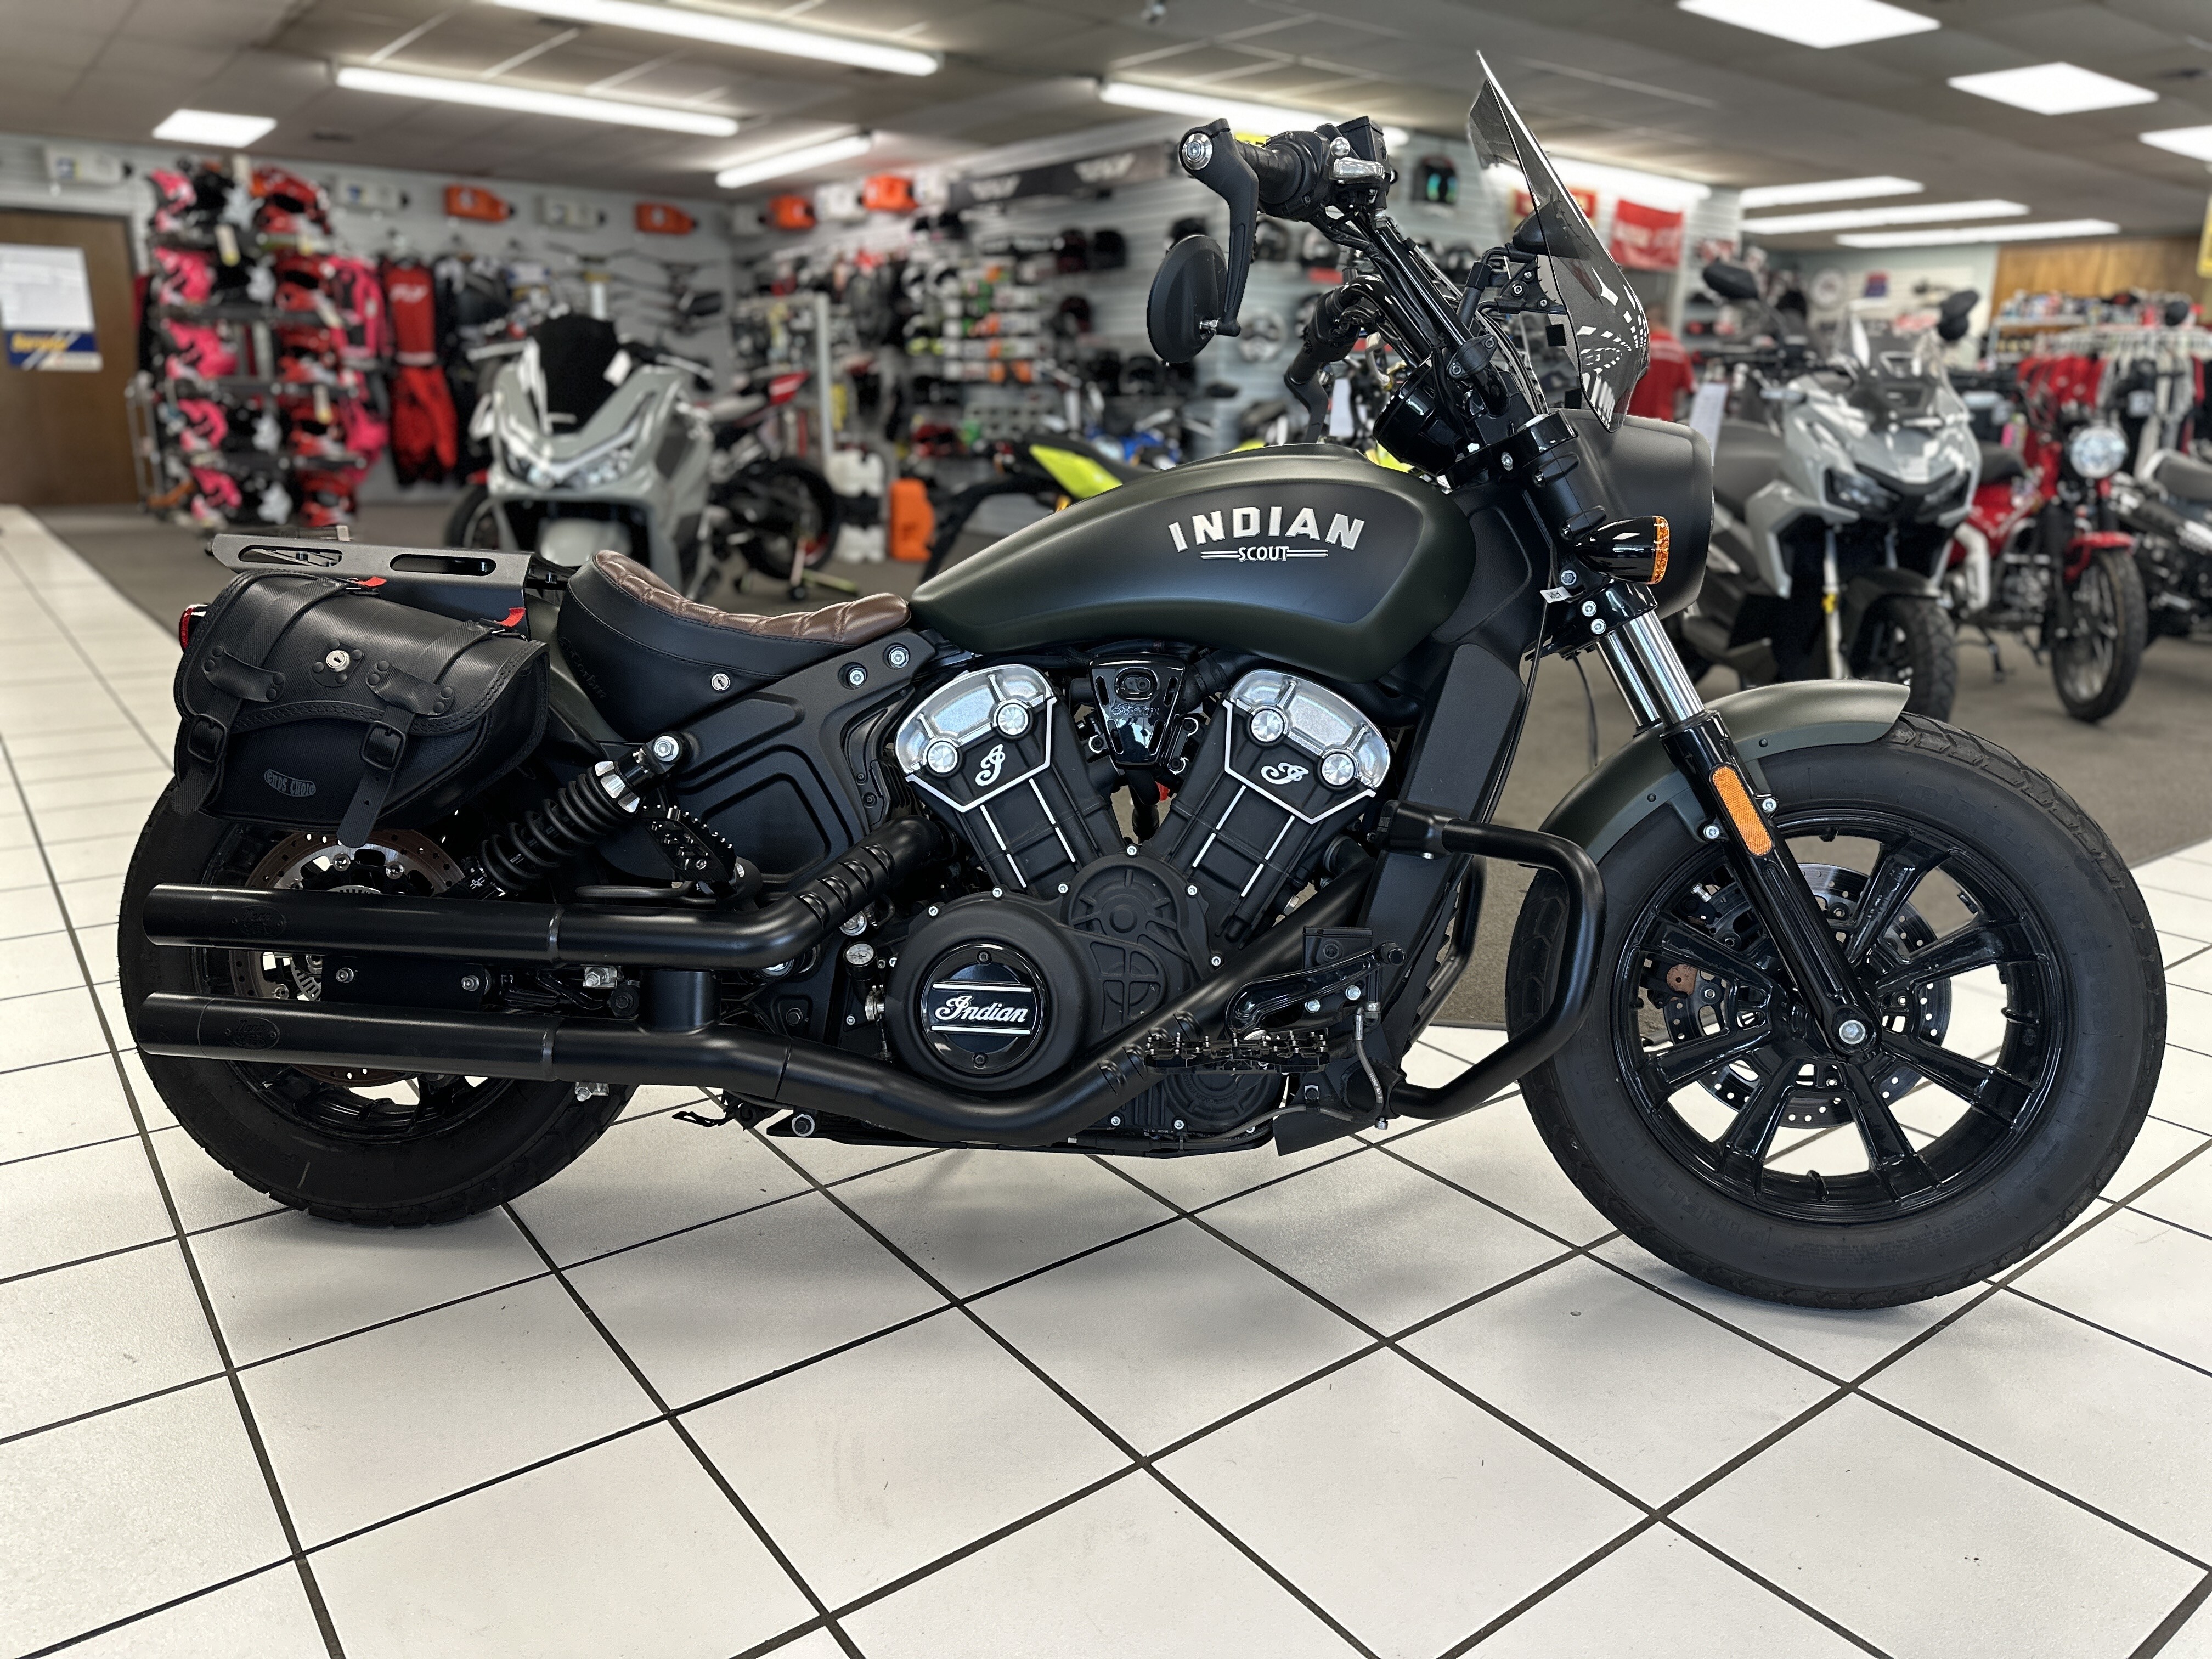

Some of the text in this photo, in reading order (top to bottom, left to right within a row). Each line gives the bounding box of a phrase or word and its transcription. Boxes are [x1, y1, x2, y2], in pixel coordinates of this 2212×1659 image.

[1168, 506, 1365, 551] INDIAN
[1238, 546, 1289, 562] SCOUT
[934, 995, 1028, 1023] Indian
